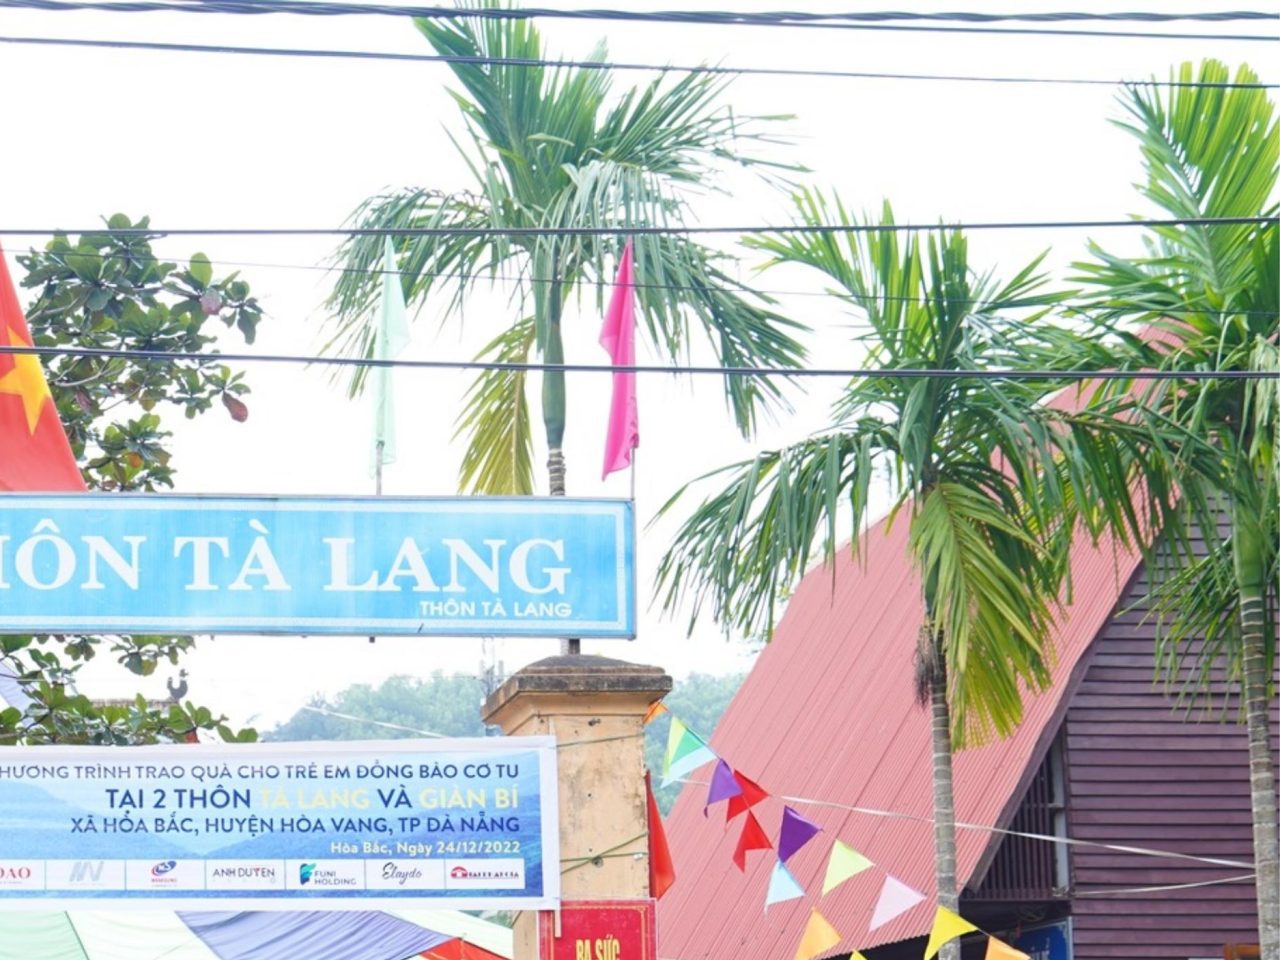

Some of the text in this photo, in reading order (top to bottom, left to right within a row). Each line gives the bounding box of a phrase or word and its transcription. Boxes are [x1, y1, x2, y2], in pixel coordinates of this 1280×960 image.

[173, 518, 291, 591] TÀ
[322, 536, 571, 595] LANG
[420, 599, 572, 617] THÔN TÀ LANG
[74, 763, 131, 779] TRÌNH
[135, 765, 185, 779] TRAO
[191, 764, 232, 782] QUÀ
[237, 765, 279, 779] CHO
[324, 765, 350, 779] EM
[463, 764, 493, 779] CƠ
[495, 764, 519, 779] TU
[105, 788, 144, 814] TẠI
[153, 788, 166, 808] 2
[174, 784, 250, 808] THÔN
[299, 786, 370, 809] LANG
[377, 784, 413, 808] VÀ
[71, 814, 96, 833] XÃ
[154, 811, 199, 836] BẮC,
[205, 814, 273, 837] HUYỆN
[281, 814, 326, 833] HÒA
[331, 817, 393, 836] VANG,
[398, 817, 420, 833] TP
[426, 814, 451, 833] ĐÀ
[460, 811, 520, 833] NẴNG
[331, 841, 520, 857] Hòa Bắc, Ngày 24/12/2022
[213, 867, 235, 878] ANH
